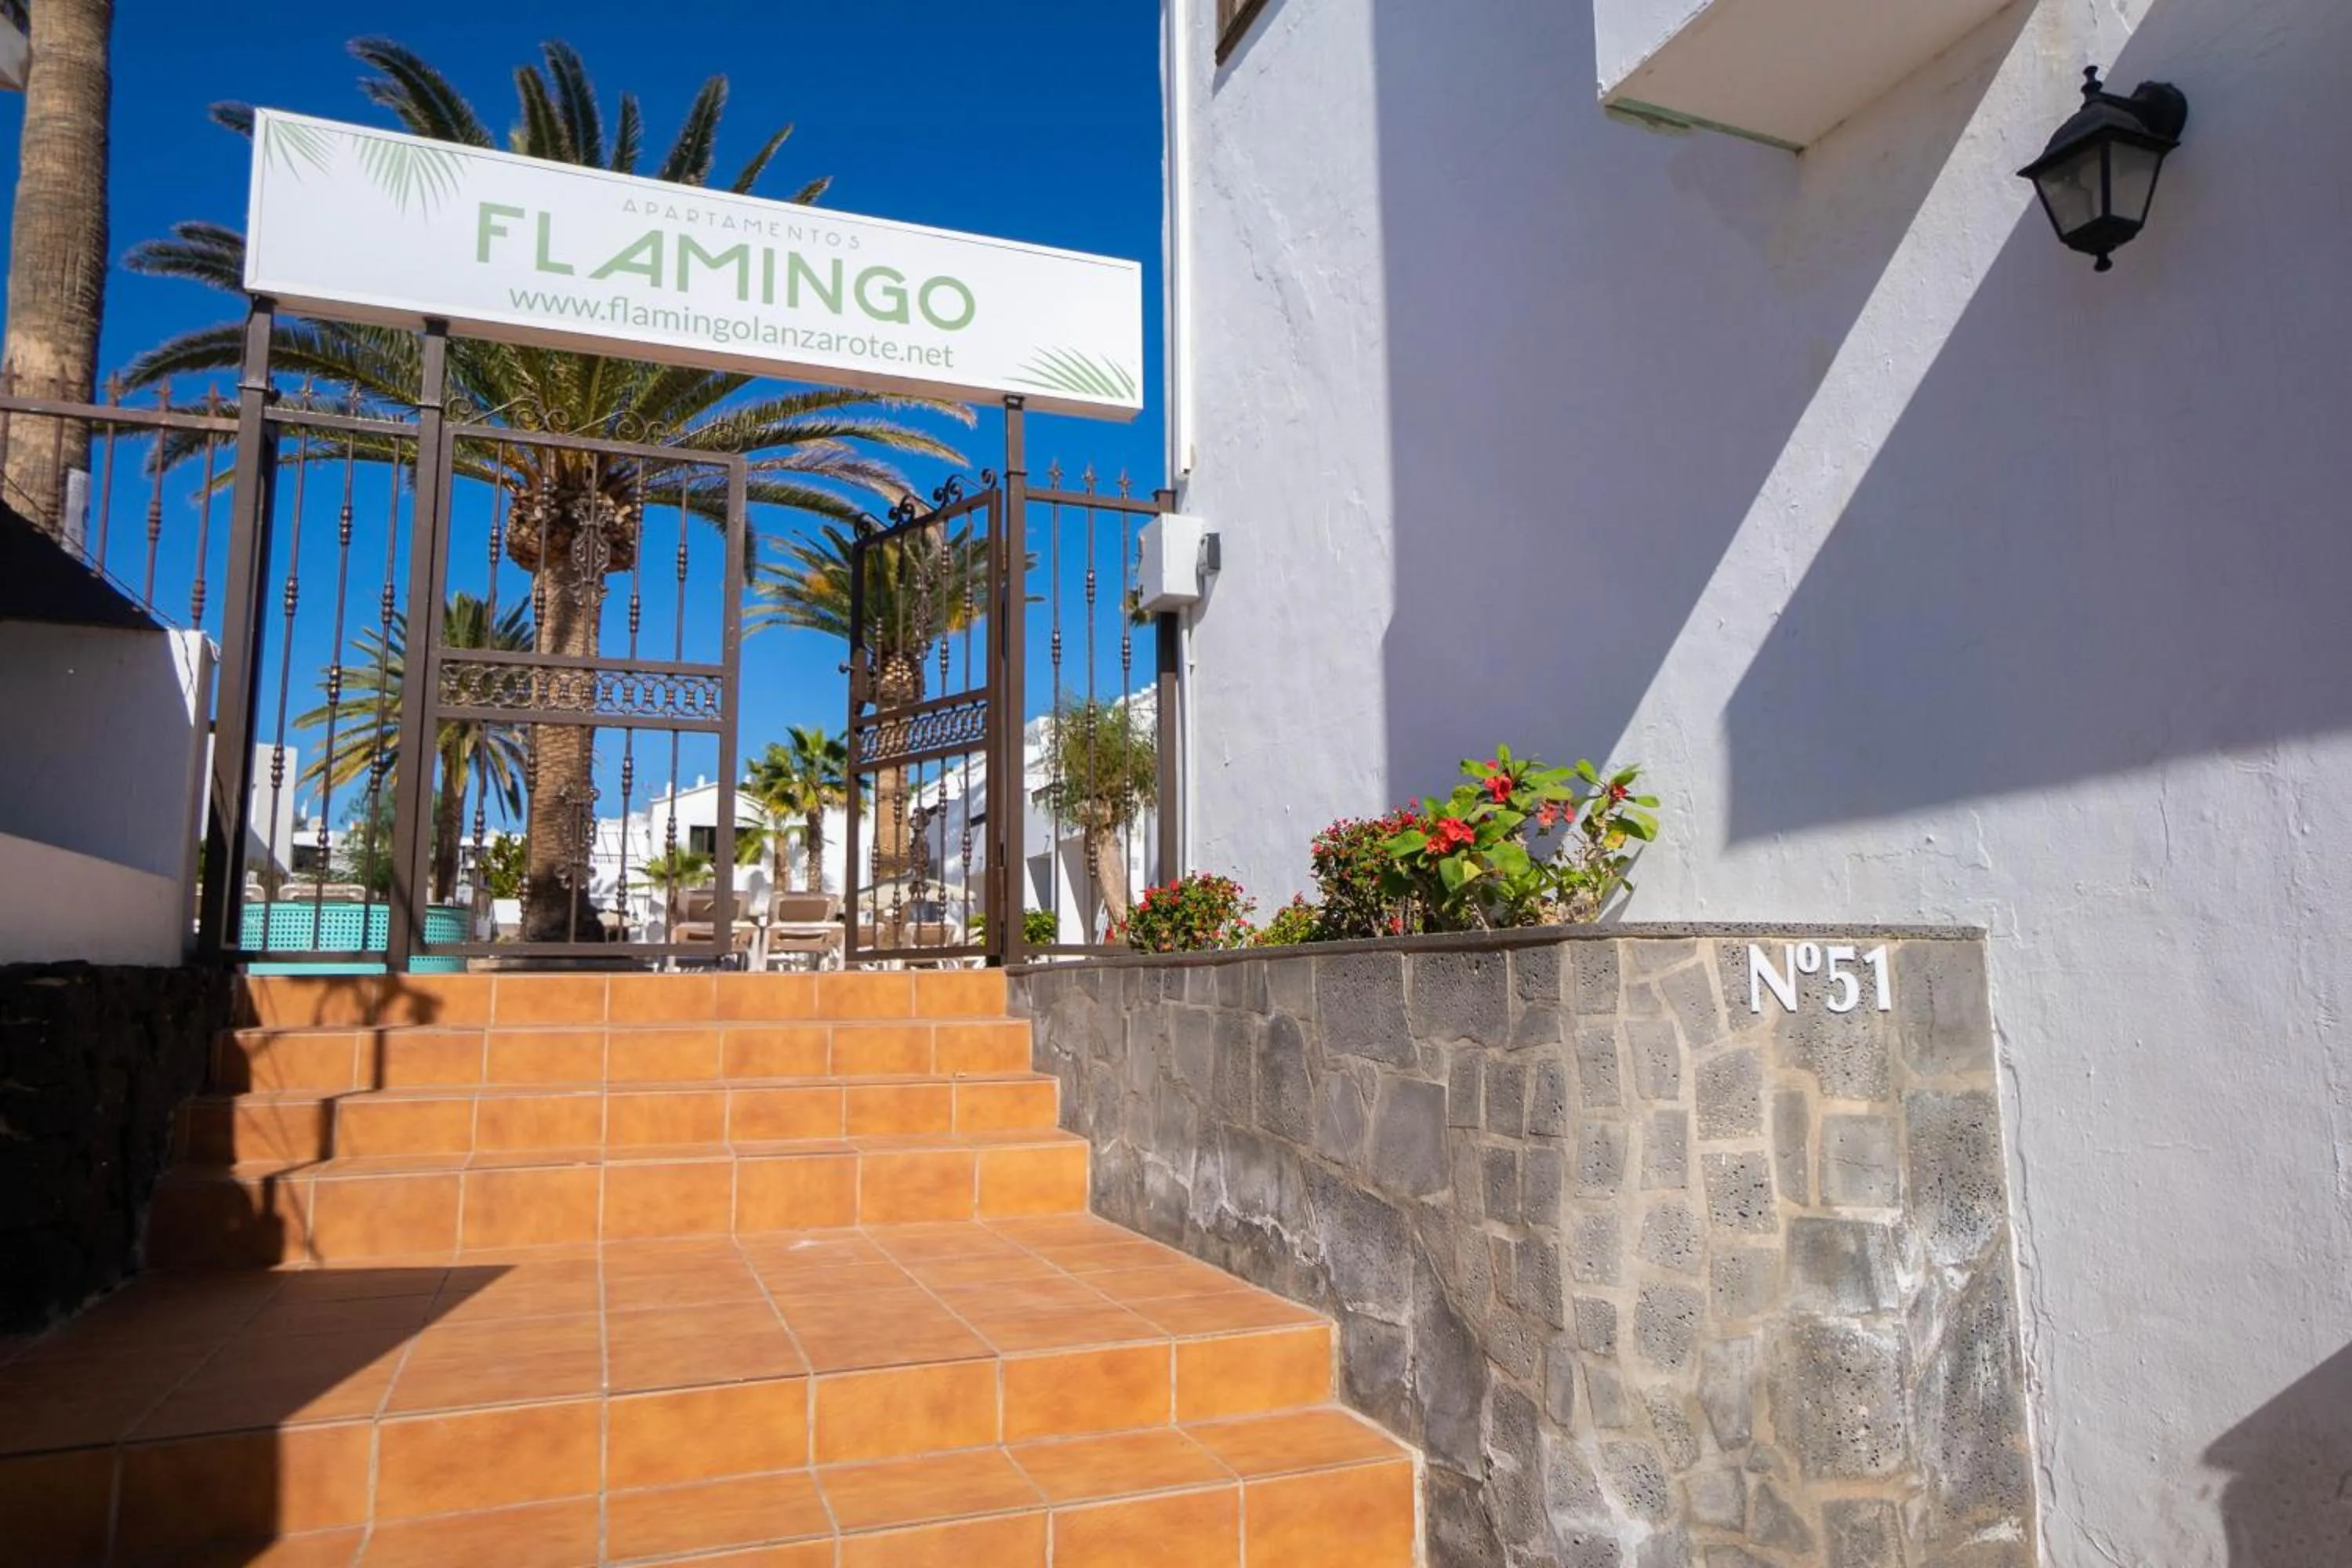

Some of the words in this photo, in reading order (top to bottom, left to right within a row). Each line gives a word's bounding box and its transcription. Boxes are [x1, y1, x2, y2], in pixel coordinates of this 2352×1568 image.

[622, 198, 861, 250] APARTAMENTOS
[476, 201, 976, 332] FLAMINGO
[509, 288, 955, 368] www.flamingolanzarote.net
